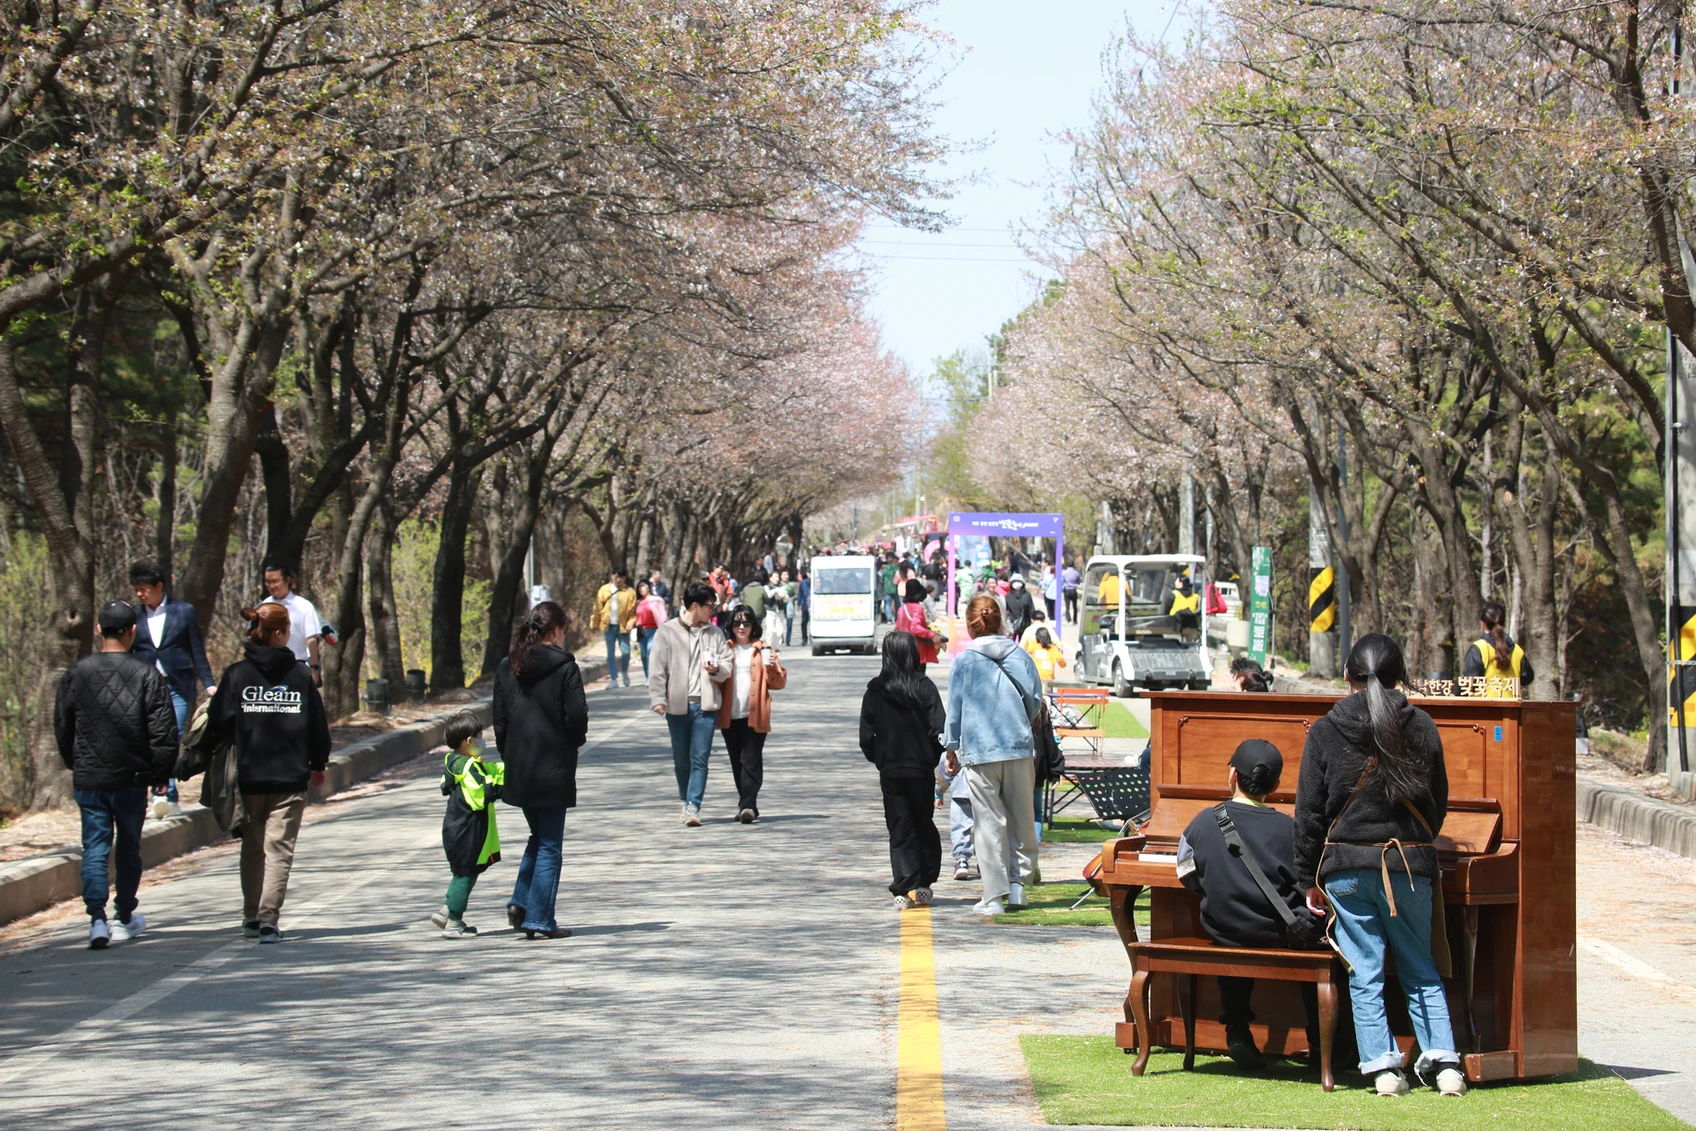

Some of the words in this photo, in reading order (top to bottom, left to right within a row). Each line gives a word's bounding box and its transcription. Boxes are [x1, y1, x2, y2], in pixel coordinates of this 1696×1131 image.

[242, 685, 301, 702] Gleam
[1458, 675, 1520, 698] 벚꽃축제
[241, 704, 301, 713] International
